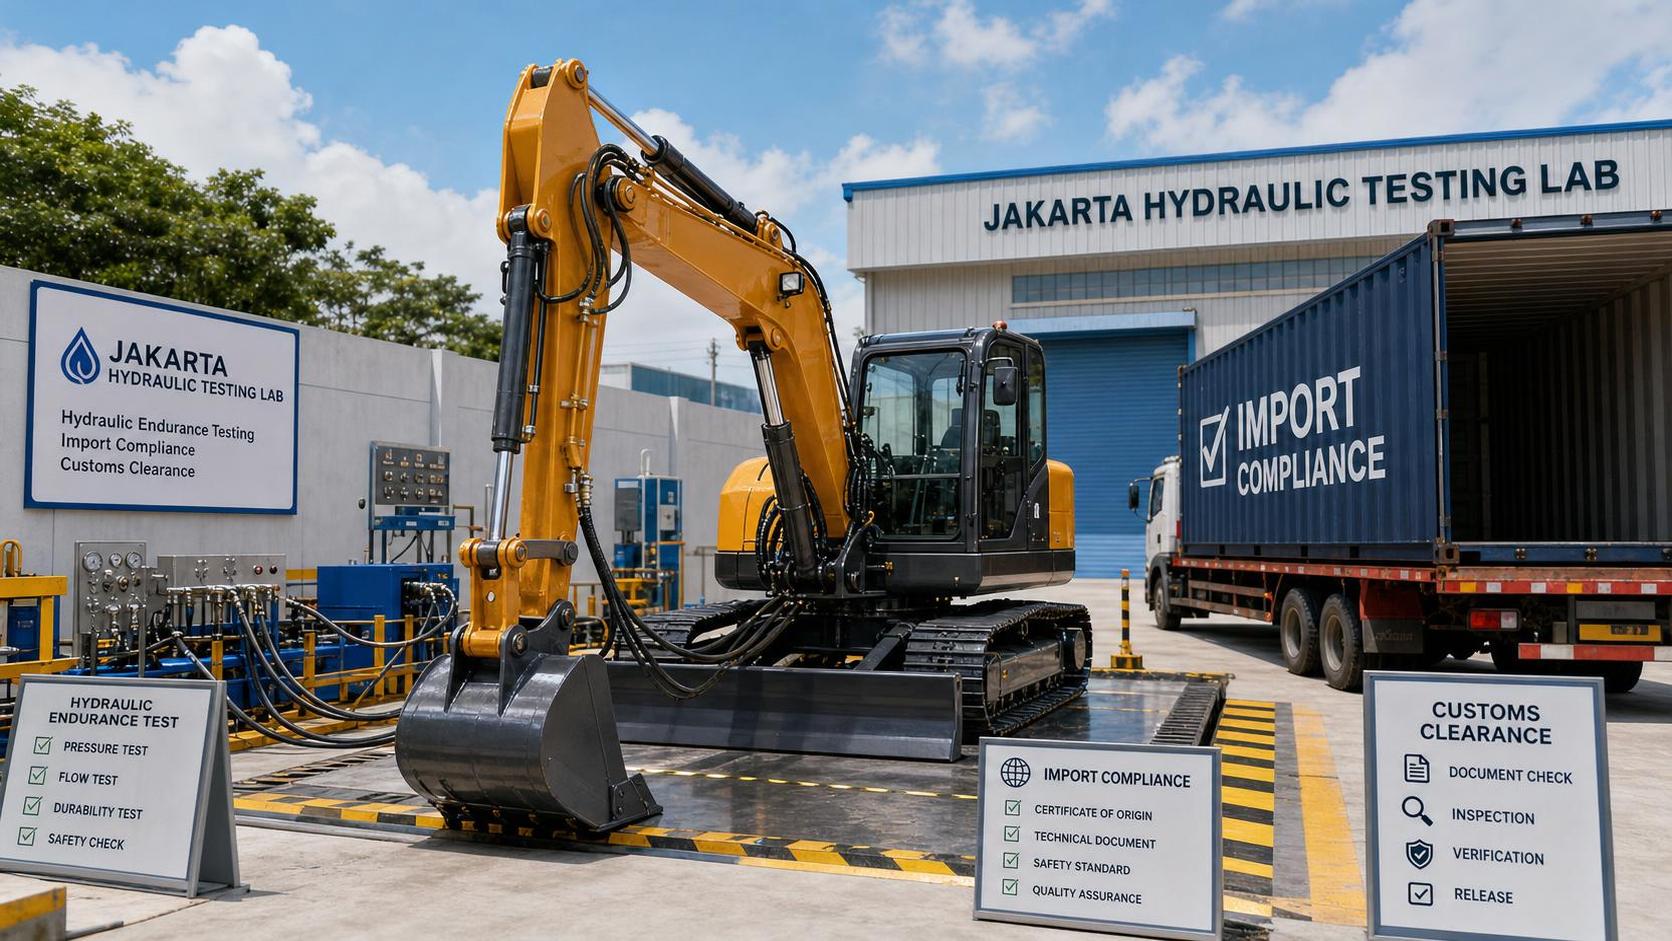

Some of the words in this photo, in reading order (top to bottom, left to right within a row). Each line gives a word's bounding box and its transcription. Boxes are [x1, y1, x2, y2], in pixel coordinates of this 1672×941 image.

[984, 195, 1133, 231] JAKARTA
[1145, 178, 1350, 220] HYDRAULIC
[1362, 166, 1526, 205] TESTING
[1541, 160, 1619, 194] LAB
[109, 340, 228, 377] JAKARTA
[108, 368, 196, 392] HYDRAULIC
[201, 380, 256, 399] TESTING
[261, 388, 283, 402] LAB
[1238, 366, 1361, 451] IMPORT
[62, 410, 132, 429] Hydraulic
[139, 417, 208, 436] Endurance
[212, 424, 254, 443] Testing
[62, 433, 111, 452] Import
[116, 438, 195, 457] Compliance
[61, 457, 124, 474] Customs
[130, 461, 195, 477] Clearance
[1238, 433, 1385, 495] COMPLIANCE
[71, 697, 152, 711] HYDRAULIC
[1433, 702, 1540, 721] CUSTOMS
[49, 712, 138, 726] ENDURANCE
[143, 716, 179, 728] TEST
[1421, 724, 1551, 744] CLEARANCE
[64, 742, 118, 754] PRESSURE
[123, 745, 148, 756] TEST
[59, 772, 89, 783] FLOW
[93, 774, 118, 785] TEST
[1045, 768, 1098, 783] IMPORT
[1102, 771, 1190, 788] COMPLIANCE
[1450, 766, 1523, 781] DOCUMENT
[1527, 770, 1572, 784] CHECK
[54, 803, 115, 817] DURABILITY
[118, 808, 143, 819] TEST
[1035, 805, 1097, 817] CERTIFICATE
[1100, 809, 1113, 818] OF
[1117, 810, 1152, 821] ORIGIN
[1453, 808, 1534, 824] INSPECTION
[48, 833, 87, 846] SAFETY
[89, 837, 124, 850] CHECK
[1035, 831, 1092, 844] TECHNICAL
[1096, 836, 1156, 849] DOCUMENT
[1453, 847, 1544, 865] VERIFICATION
[1034, 858, 1072, 870] SAFETY
[1075, 862, 1130, 875] STANDARD
[1033, 885, 1076, 897] QUALITY
[1079, 890, 1141, 904] ASSURANCE
[1455, 888, 1513, 904] RELEASE
